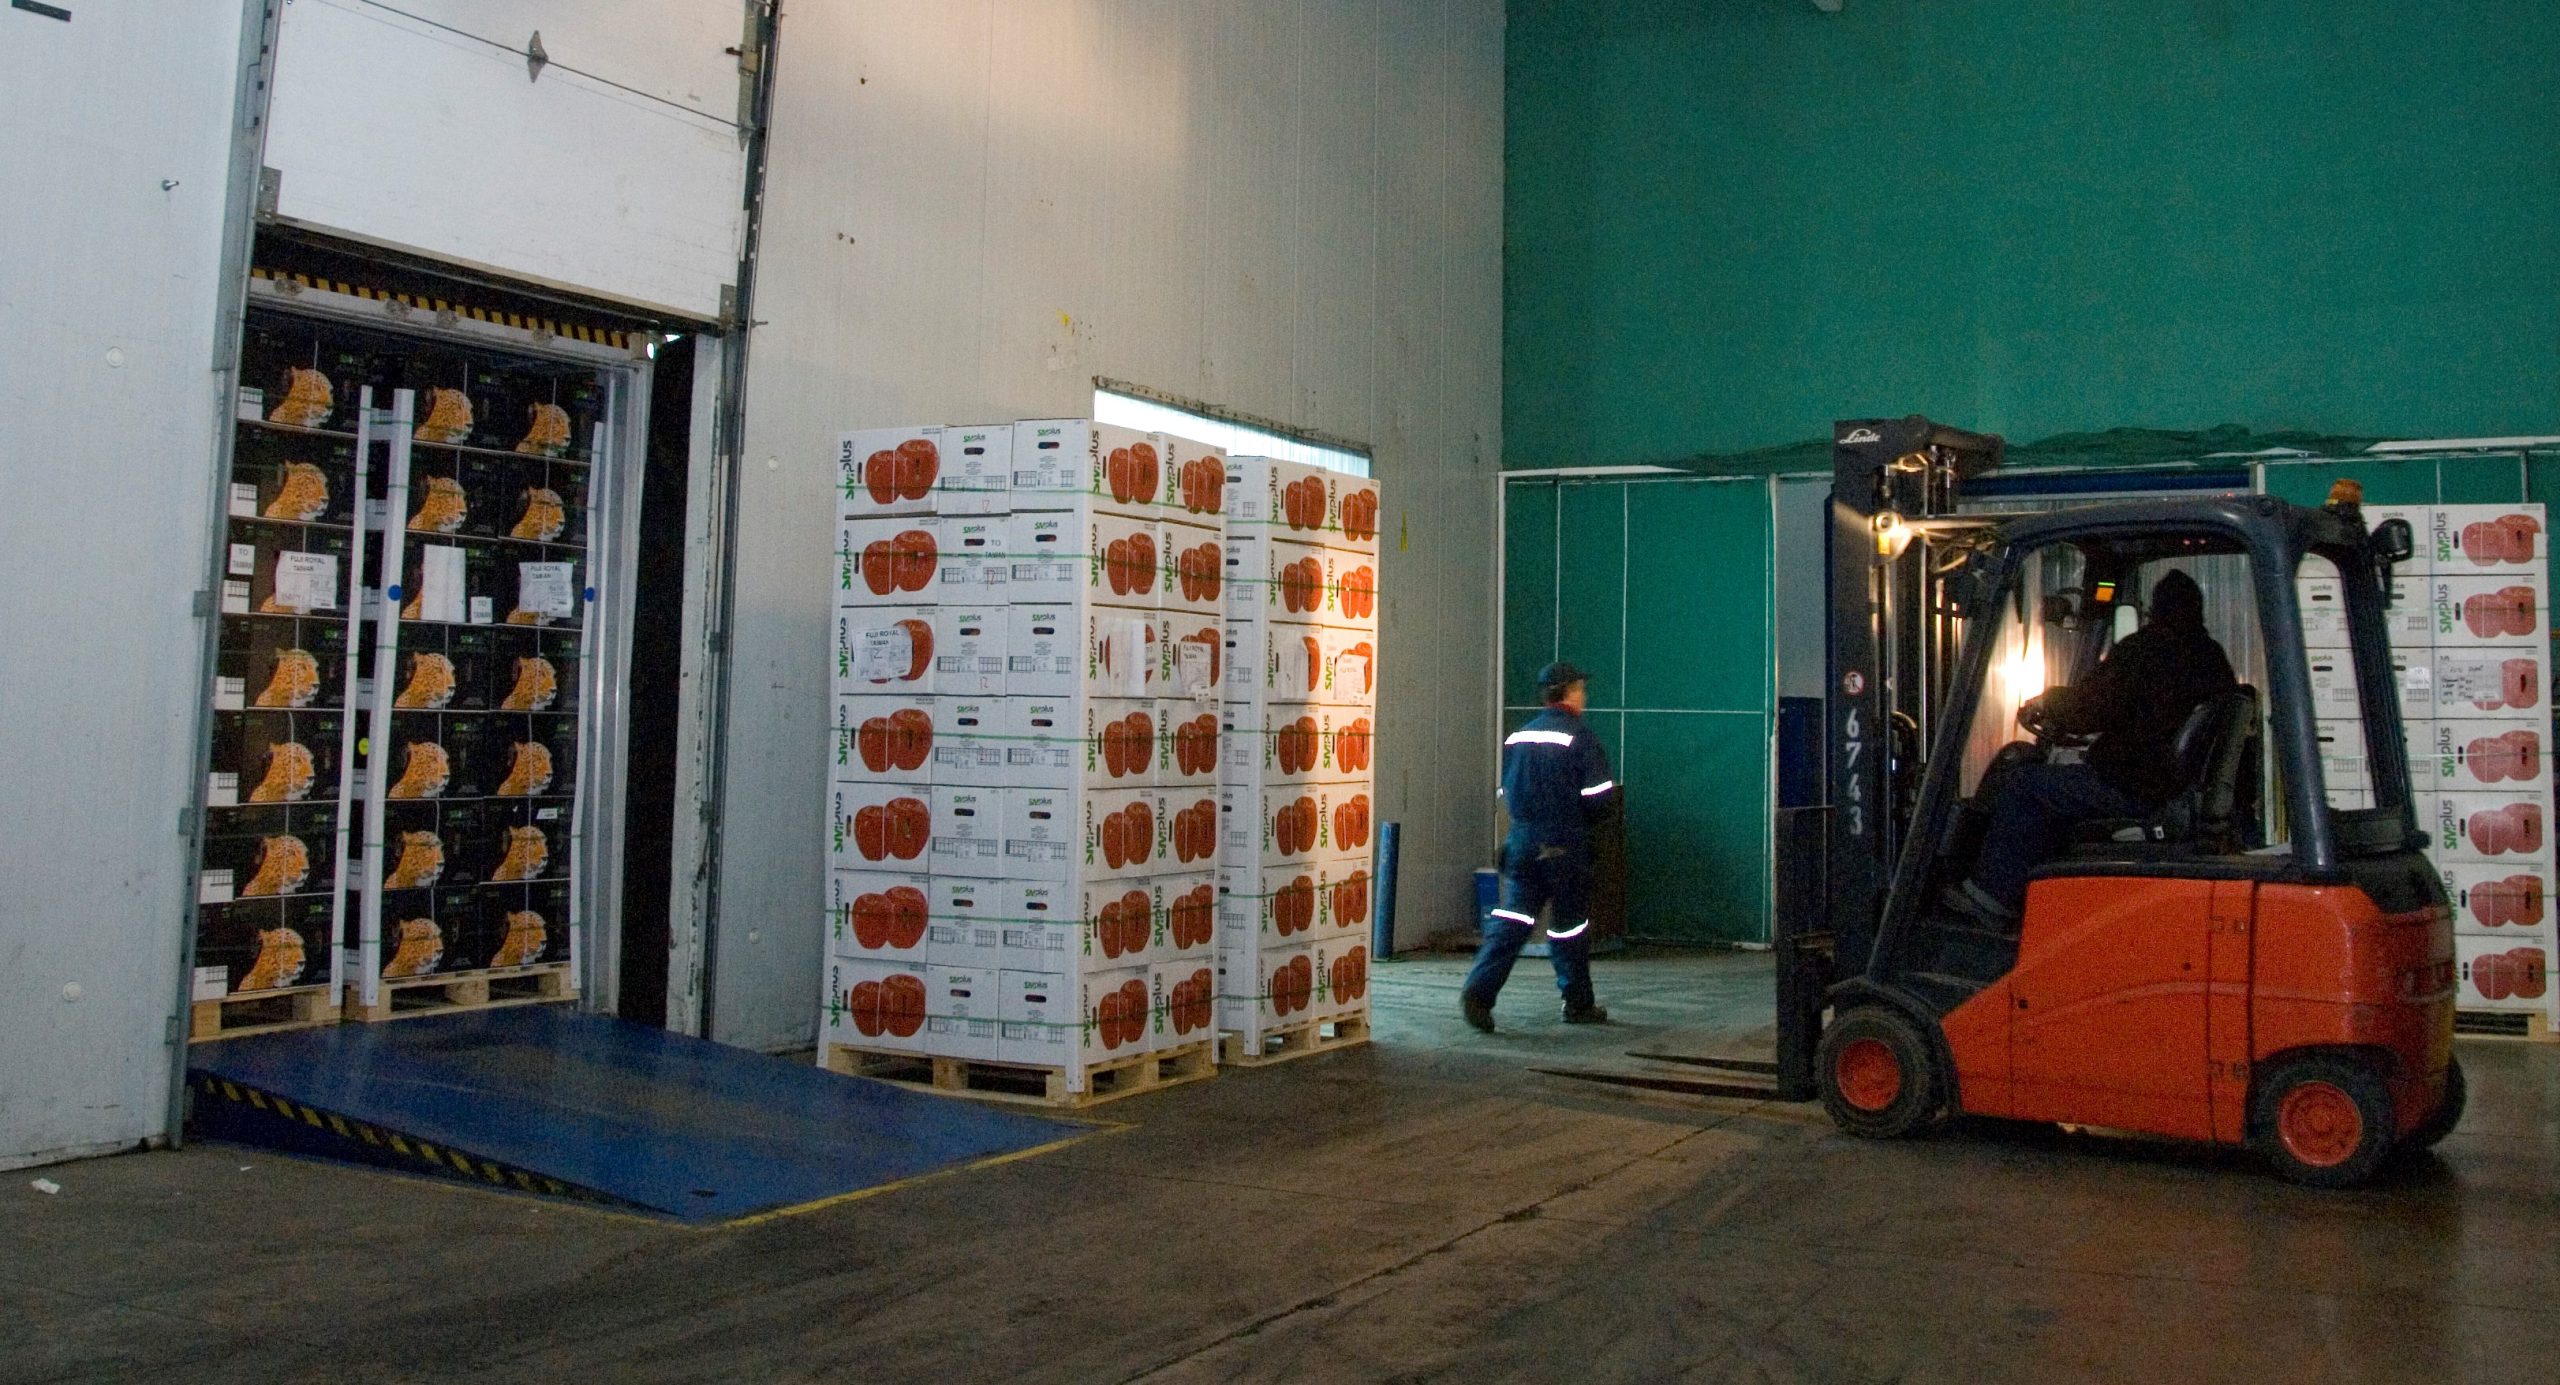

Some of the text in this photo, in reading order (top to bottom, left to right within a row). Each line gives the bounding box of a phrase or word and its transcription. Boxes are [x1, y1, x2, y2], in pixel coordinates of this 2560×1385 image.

[1838, 429, 1881, 444] Linde
[985, 551, 1006, 559] TAIWAN
[866, 631, 878, 639] FUJI
[1845, 707, 1863, 836] 6743
